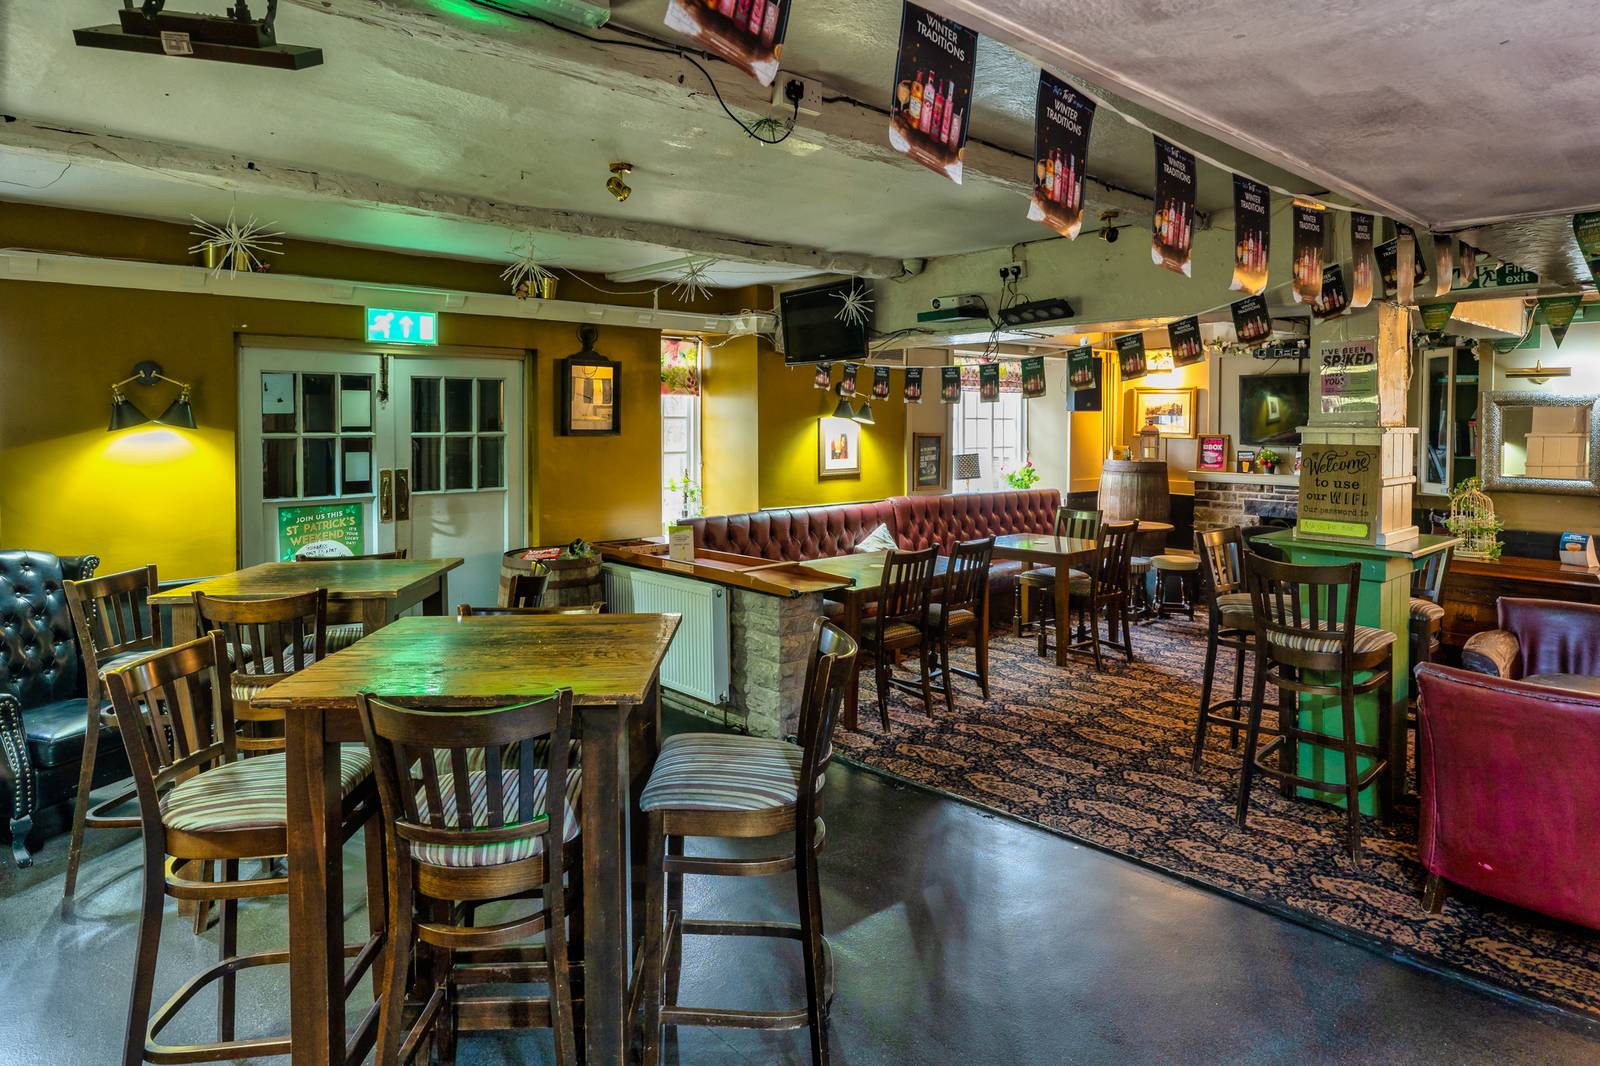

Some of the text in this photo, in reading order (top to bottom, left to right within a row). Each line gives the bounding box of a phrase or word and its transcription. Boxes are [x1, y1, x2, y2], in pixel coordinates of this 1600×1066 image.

[926, 13, 958, 44] WINTER
[917, 20, 965, 62] TRADITIONS
[1054, 98, 1078, 122] WINTER
[1046, 106, 1082, 136] TRADITIONS
[1167, 155, 1186, 172] WINTER
[1163, 162, 1191, 184] TRADITIONS
[1244, 191, 1261, 204] WINTER
[1240, 199, 1265, 215] TRADITIONS
[1505, 272, 1529, 284] exit
[1321, 346, 1366, 356] I'VE BEEN
[1302, 449, 1374, 476] Welcome
[1315, 477, 1360, 490] to use
[1306, 492, 1327, 501] our
[296, 515, 314, 524] JOIN
[326, 510, 343, 519] THIS
[286, 516, 356, 536] ST PATRICK'S
[290, 529, 344, 546] WEEKEND
